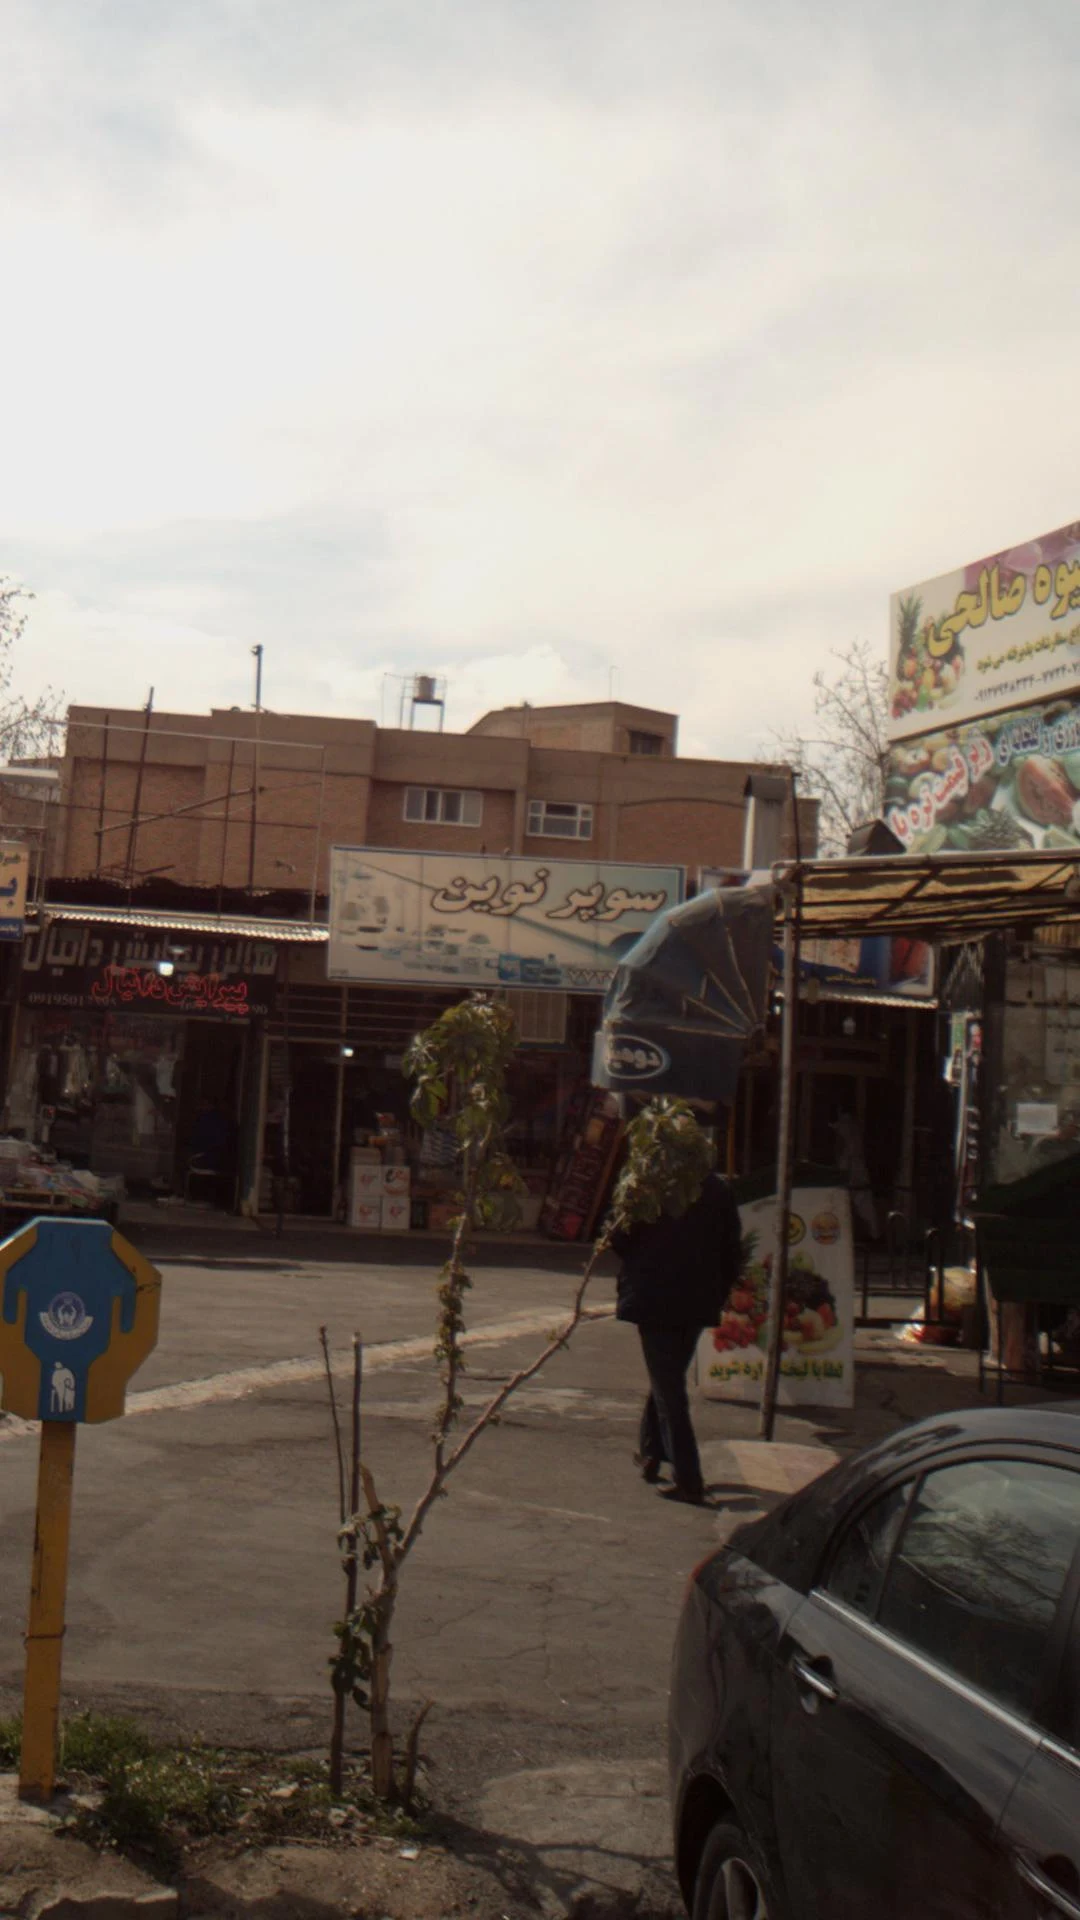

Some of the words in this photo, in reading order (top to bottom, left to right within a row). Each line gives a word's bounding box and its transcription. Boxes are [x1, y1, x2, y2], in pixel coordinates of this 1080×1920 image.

[927, 561, 1027, 658] صالحی
[1034, 557, 1080, 621] یوه
[431, 867, 551, 917] نوین
[545, 881, 667, 923] سوپر
[23, 926, 104, 977] دانیال
